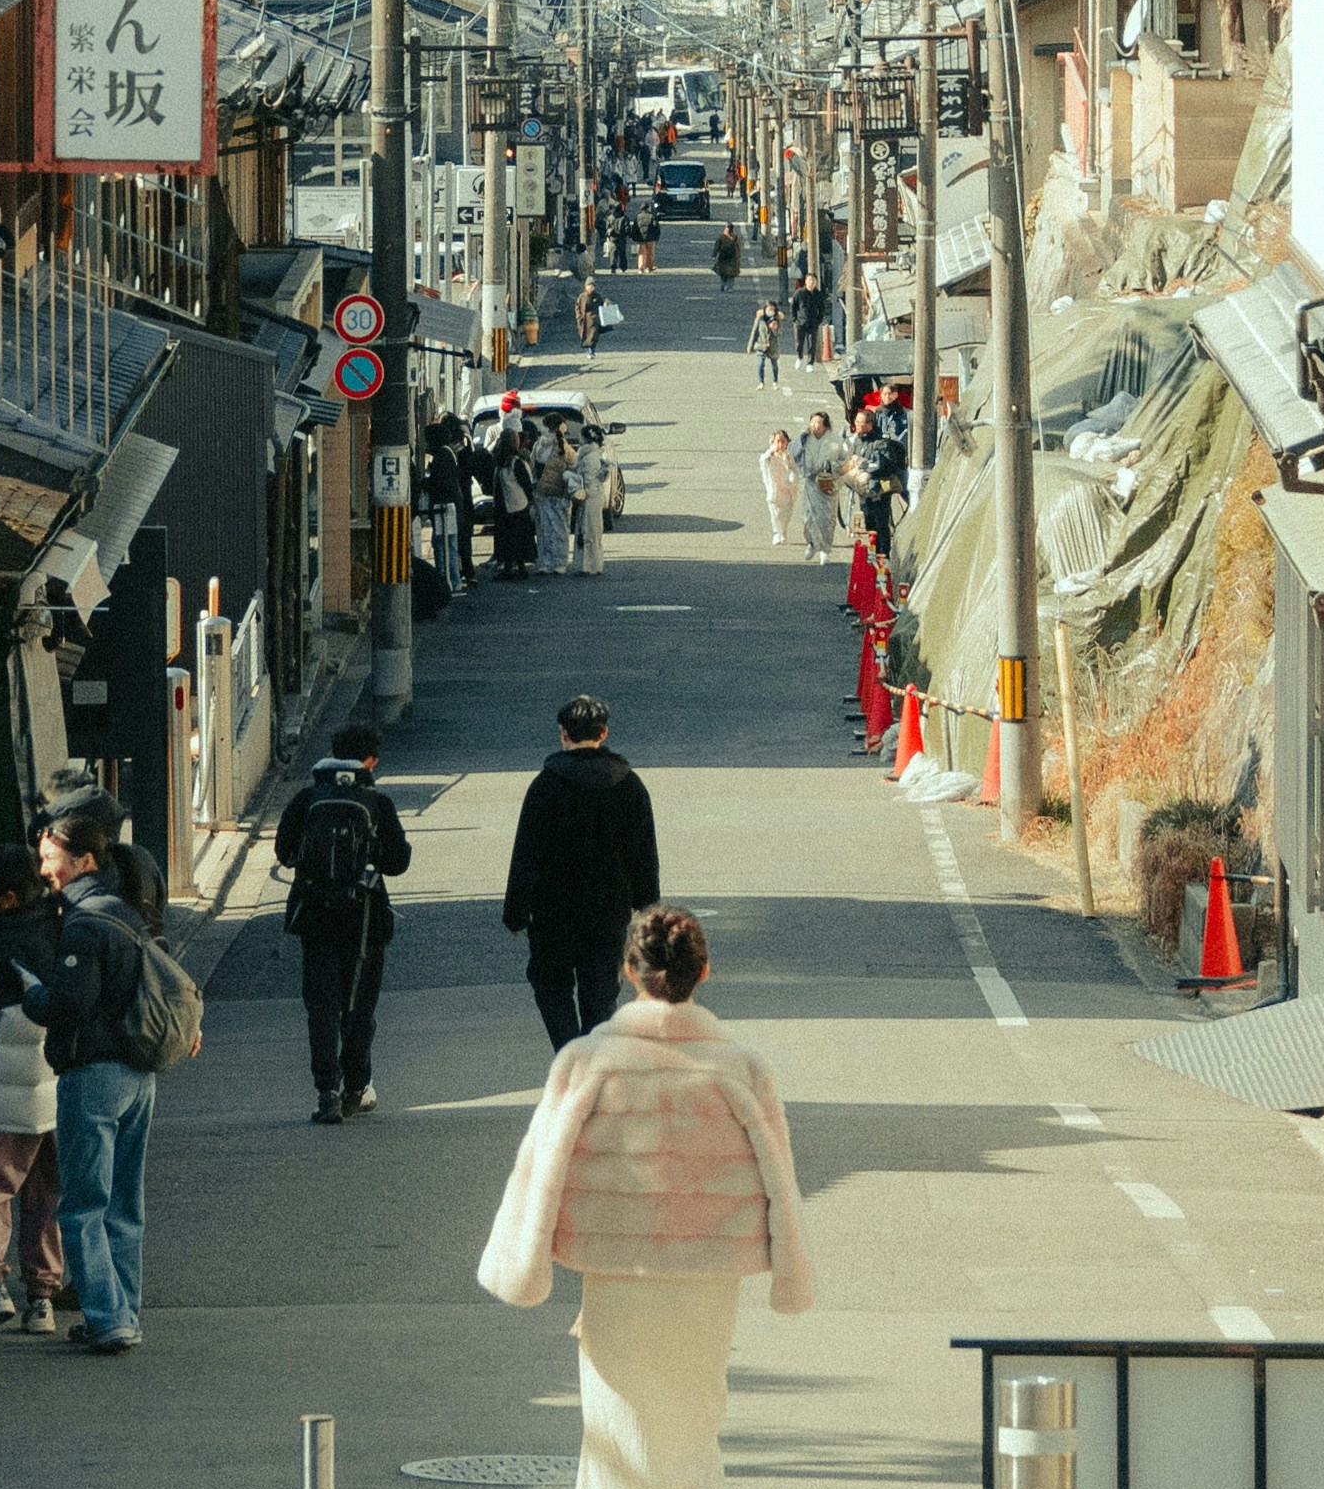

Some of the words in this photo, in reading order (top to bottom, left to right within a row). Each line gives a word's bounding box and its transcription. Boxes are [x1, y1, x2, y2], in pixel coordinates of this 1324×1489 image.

[67, 23, 96, 137] 繁栄会
[346, 309, 373, 331] 30
